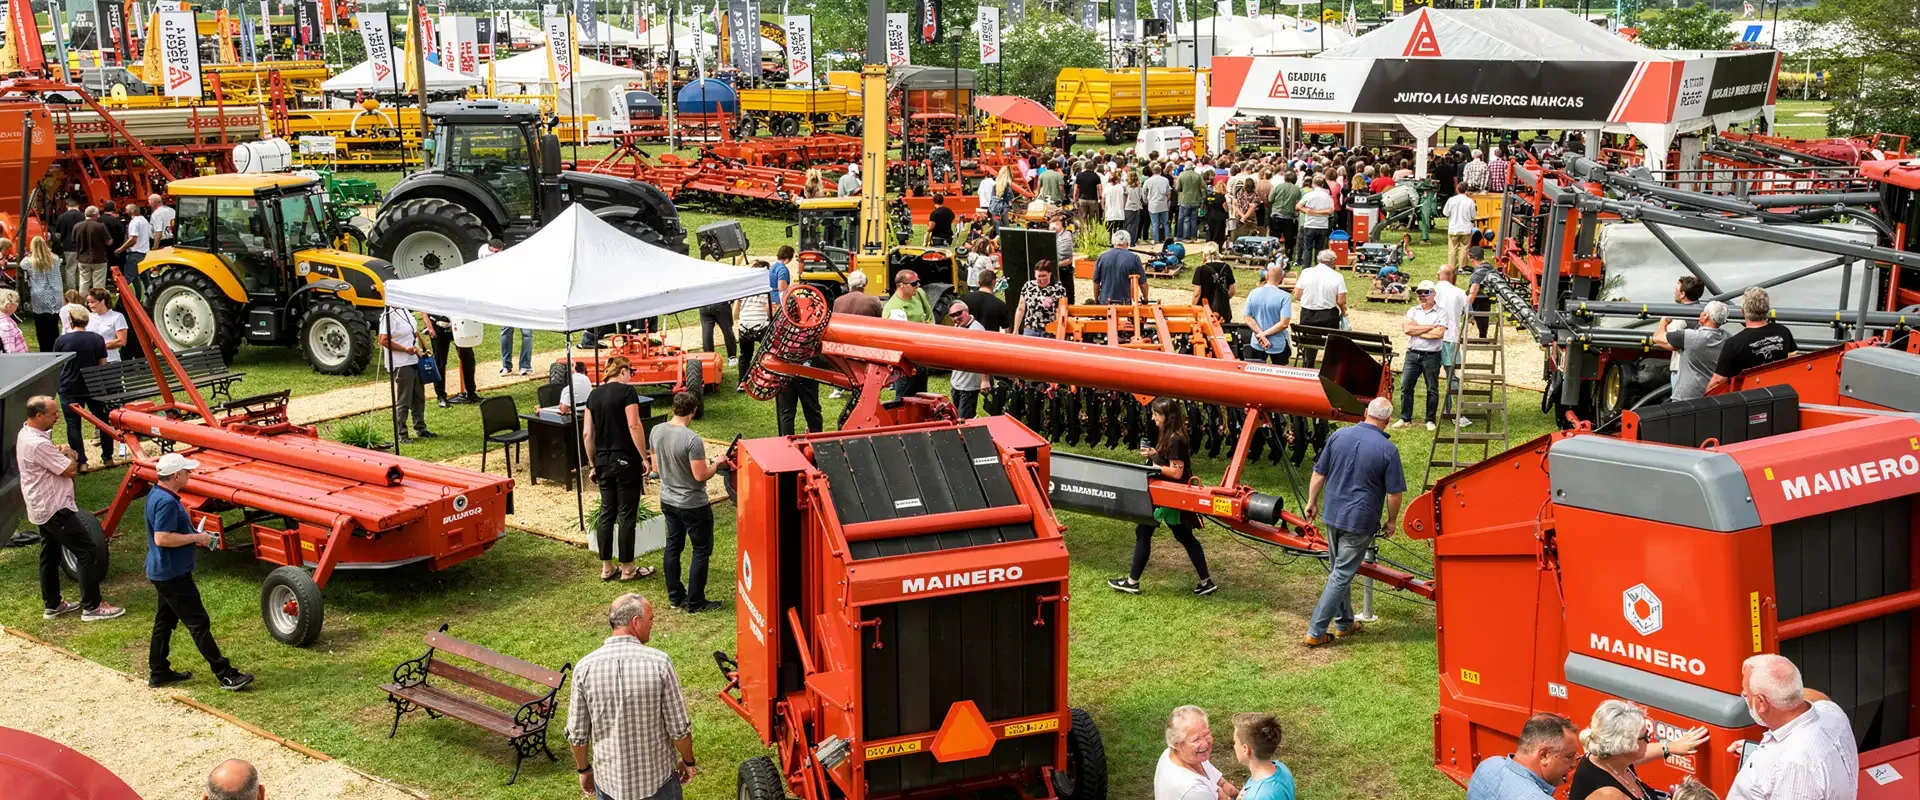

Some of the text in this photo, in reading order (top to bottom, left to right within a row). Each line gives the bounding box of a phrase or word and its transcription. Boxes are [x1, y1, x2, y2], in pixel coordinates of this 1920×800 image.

[1444, 93, 1468, 104] LAS
[1781, 454, 1919, 501] MAINERO
[902, 566, 1023, 593] MAINERO
[1590, 632, 1706, 676] MAINERO
